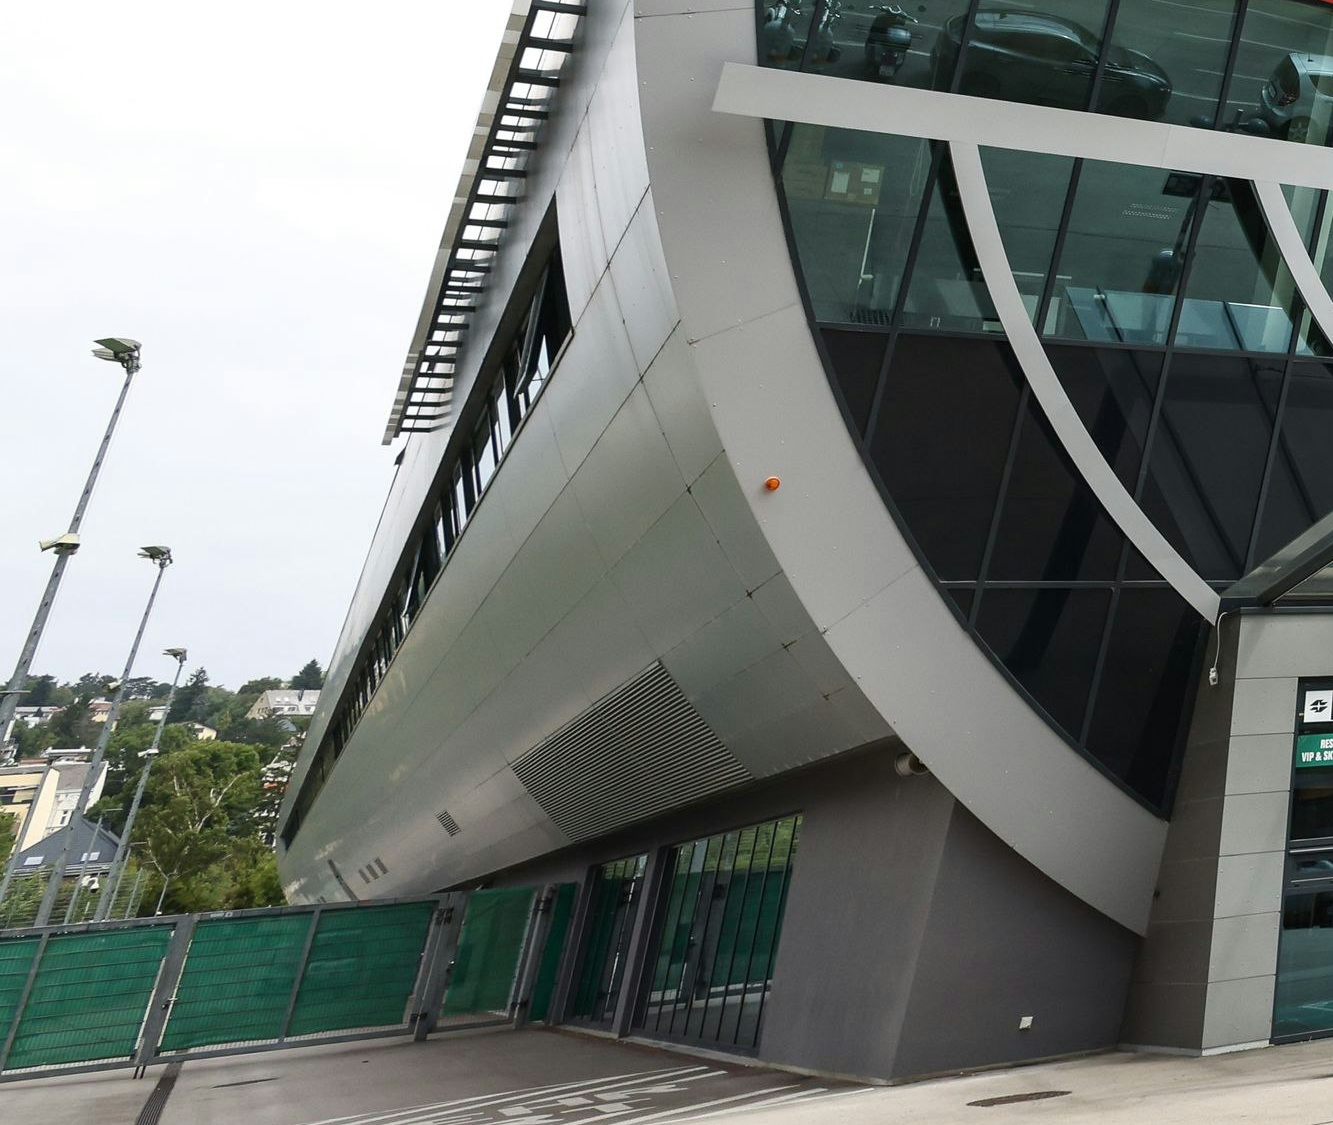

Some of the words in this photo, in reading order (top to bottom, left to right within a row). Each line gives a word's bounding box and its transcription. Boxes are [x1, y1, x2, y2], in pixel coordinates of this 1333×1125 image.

[1301, 751, 1314, 762] VIP
[1315, 750, 1322, 761] &
[1322, 750, 1333, 761] SK
